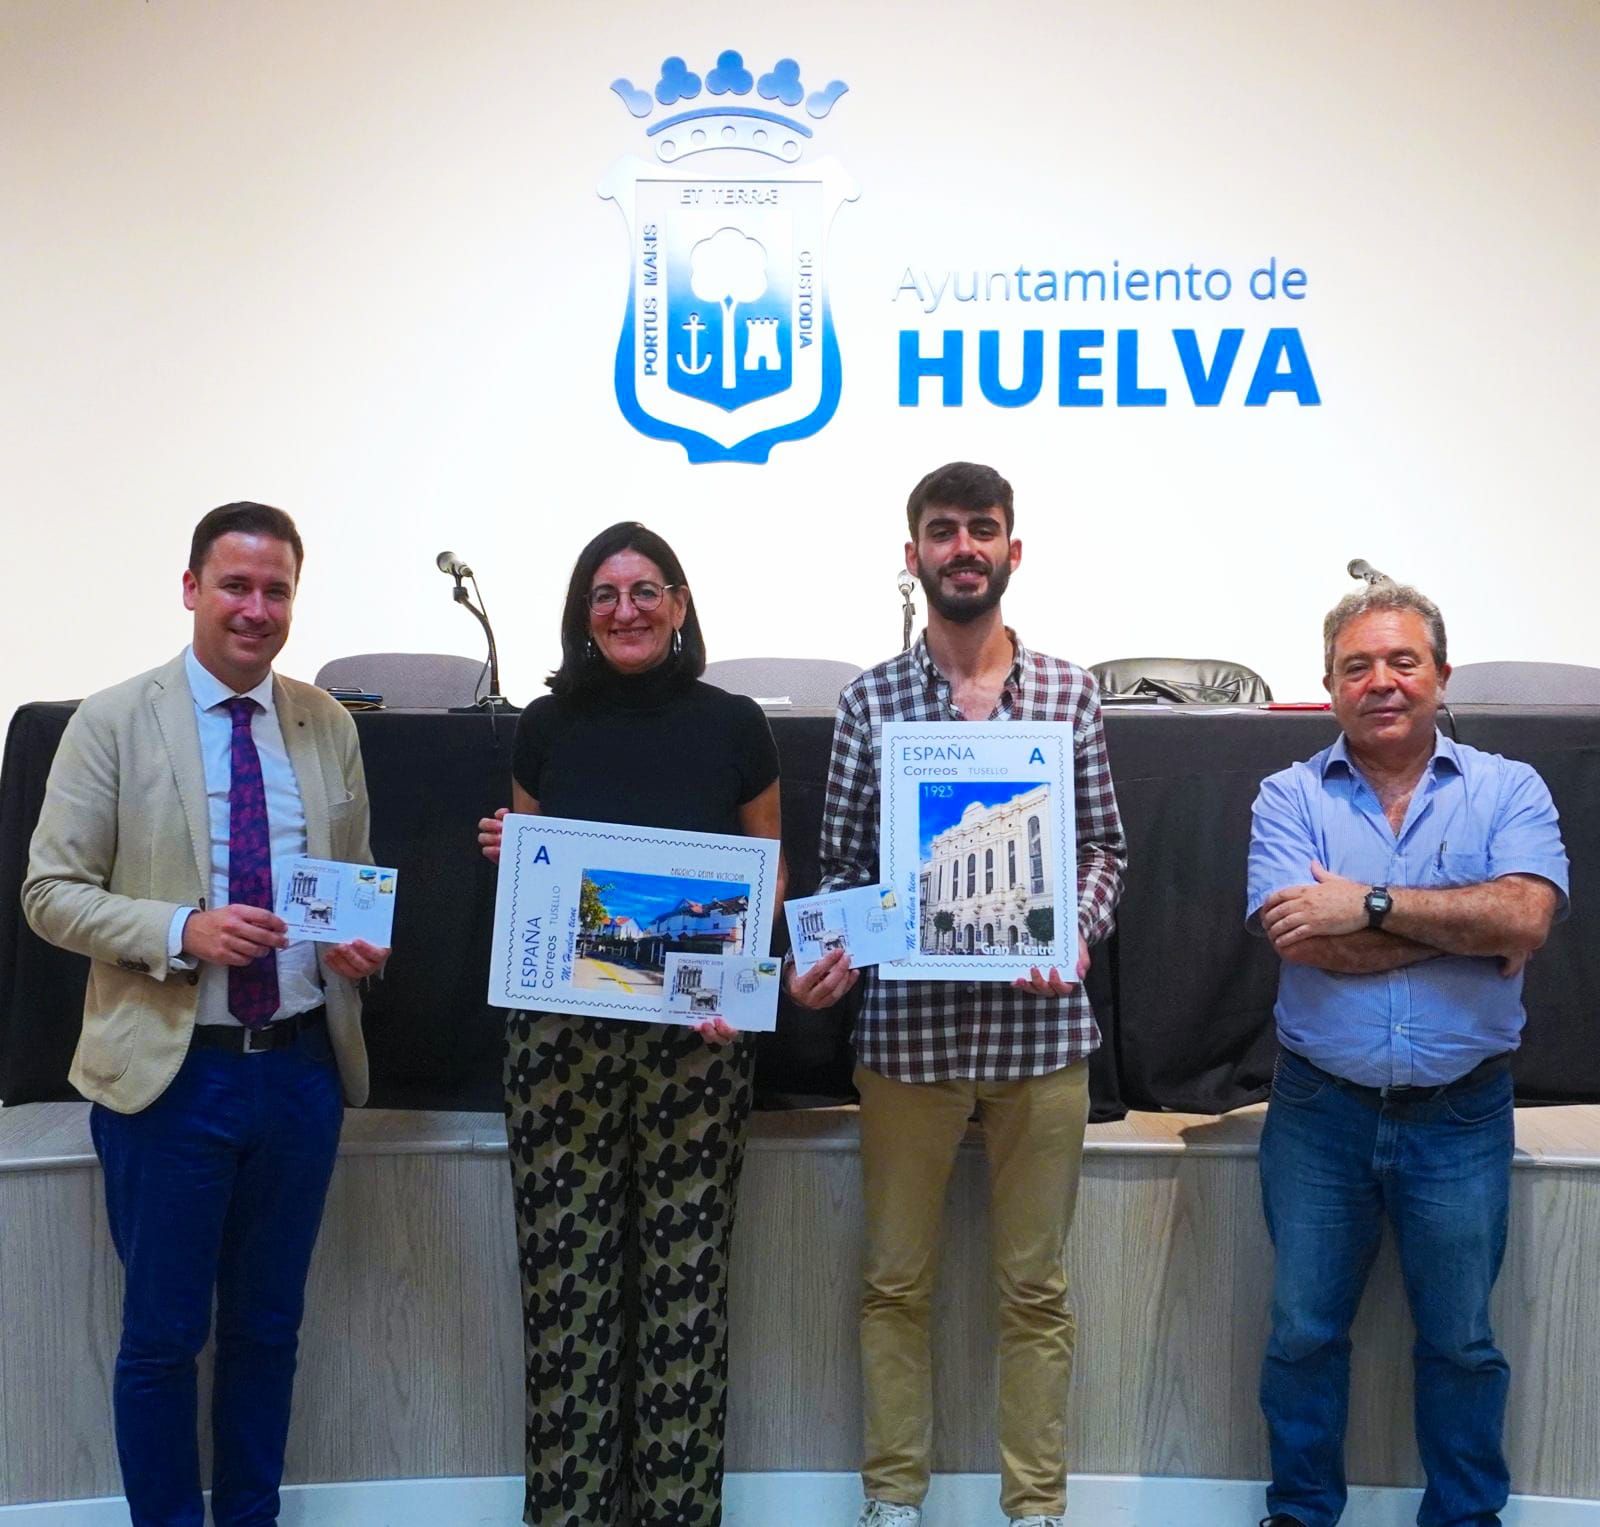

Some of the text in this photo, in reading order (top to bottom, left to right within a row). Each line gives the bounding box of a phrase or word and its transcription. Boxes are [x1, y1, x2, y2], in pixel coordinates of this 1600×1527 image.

[681, 188, 703, 205] ET
[892, 256, 1308, 314] Ayuntamiento de
[643, 224, 658, 377] PORTUS MARIS
[799, 250, 813, 350] CUSTODIA
[898, 328, 1322, 408] HUELVA
[903, 744, 976, 761] ESPAÑA
[1028, 747, 1046, 765] A
[903, 765, 1009, 776] Correos TUSELLO
[924, 785, 955, 798] 1923
[532, 845, 551, 865] A
[542, 885, 561, 990] Correos TUSELLO
[521, 916, 542, 989] ESPAÑA
[981, 942, 1056, 956] Gran Teatro
